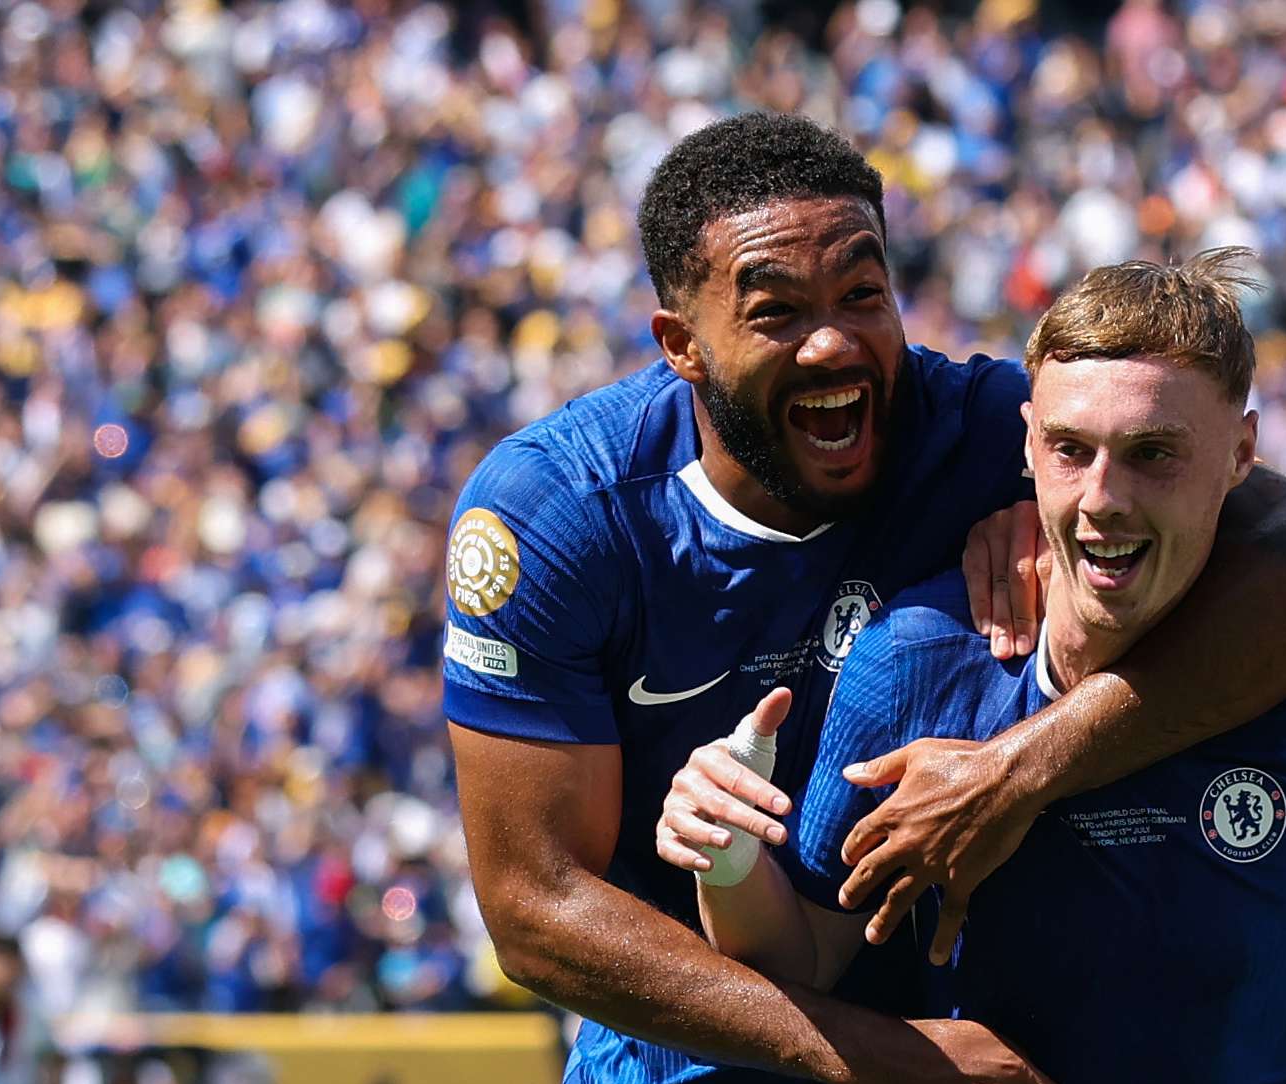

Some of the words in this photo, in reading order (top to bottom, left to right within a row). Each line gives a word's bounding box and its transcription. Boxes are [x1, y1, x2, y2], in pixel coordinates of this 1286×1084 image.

[486, 526, 506, 550] CUP
[499, 554, 510, 571] 25
[485, 574, 507, 598] USA
[455, 585, 482, 609] FIFA
[476, 640, 507, 657] UNITES
[484, 659, 506, 670] FIFA
[739, 662, 772, 673] CHELSEA
[1209, 771, 1264, 798] CHELSEA
[1100, 809, 1129, 819] WORLD
[1129, 808, 1147, 816] CUP
[1147, 807, 1169, 816] FINAL
[1105, 819, 1127, 828] PARIS
[1127, 816, 1187, 826] SAINT-GERMAIN
[1089, 829, 1117, 838] SUNDAY
[1133, 826, 1151, 835] JULY
[1097, 838, 1119, 847] YORK,
[1119, 836, 1138, 846] NEW
[1138, 834, 1167, 844] JERSEY
[1223, 846, 1259, 858] FOOTBALL
[1262, 831, 1277, 849] CLUB
